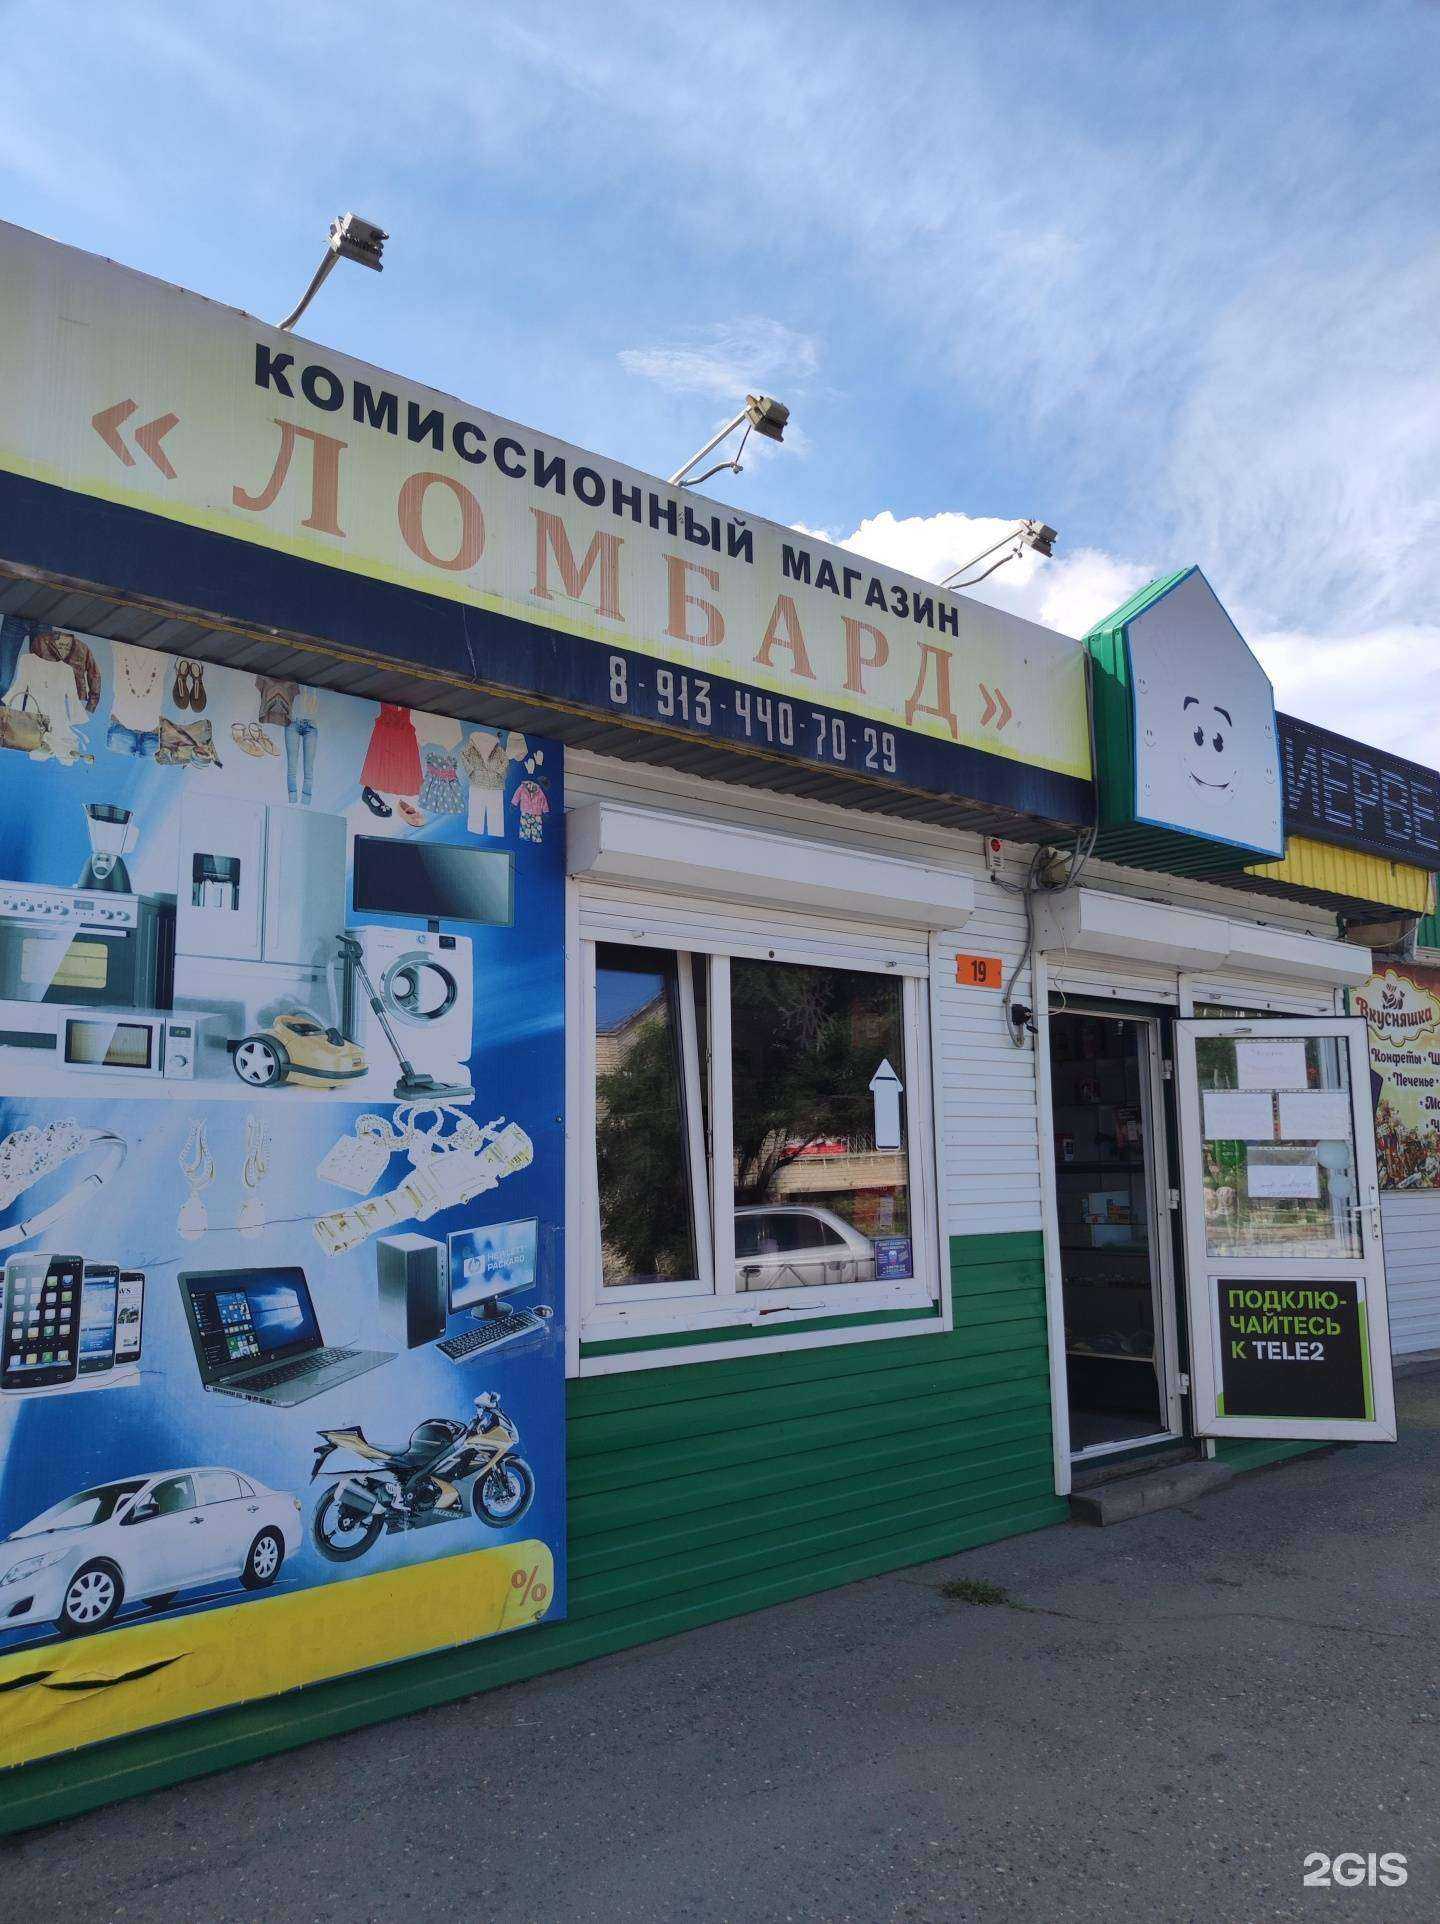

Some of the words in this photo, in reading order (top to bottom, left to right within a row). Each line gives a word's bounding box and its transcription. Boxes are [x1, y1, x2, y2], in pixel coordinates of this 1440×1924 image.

[254, 343, 754, 565] КОМИССИОННЫЙ
[782, 543, 960, 638] МАГАЗИН
[971, 960, 987, 982] 19
[1356, 996, 1433, 1031] Вкусняшка
[1371, 1048, 1422, 1066] Конфеты
[1393, 1071, 1434, 1087] Печенье
[1229, 1289, 1347, 1312] ПОДКЛЮ-
[1230, 1311, 1341, 1335] ЧАЙТЕСЬ
[1252, 1341, 1324, 1360] TELE2
